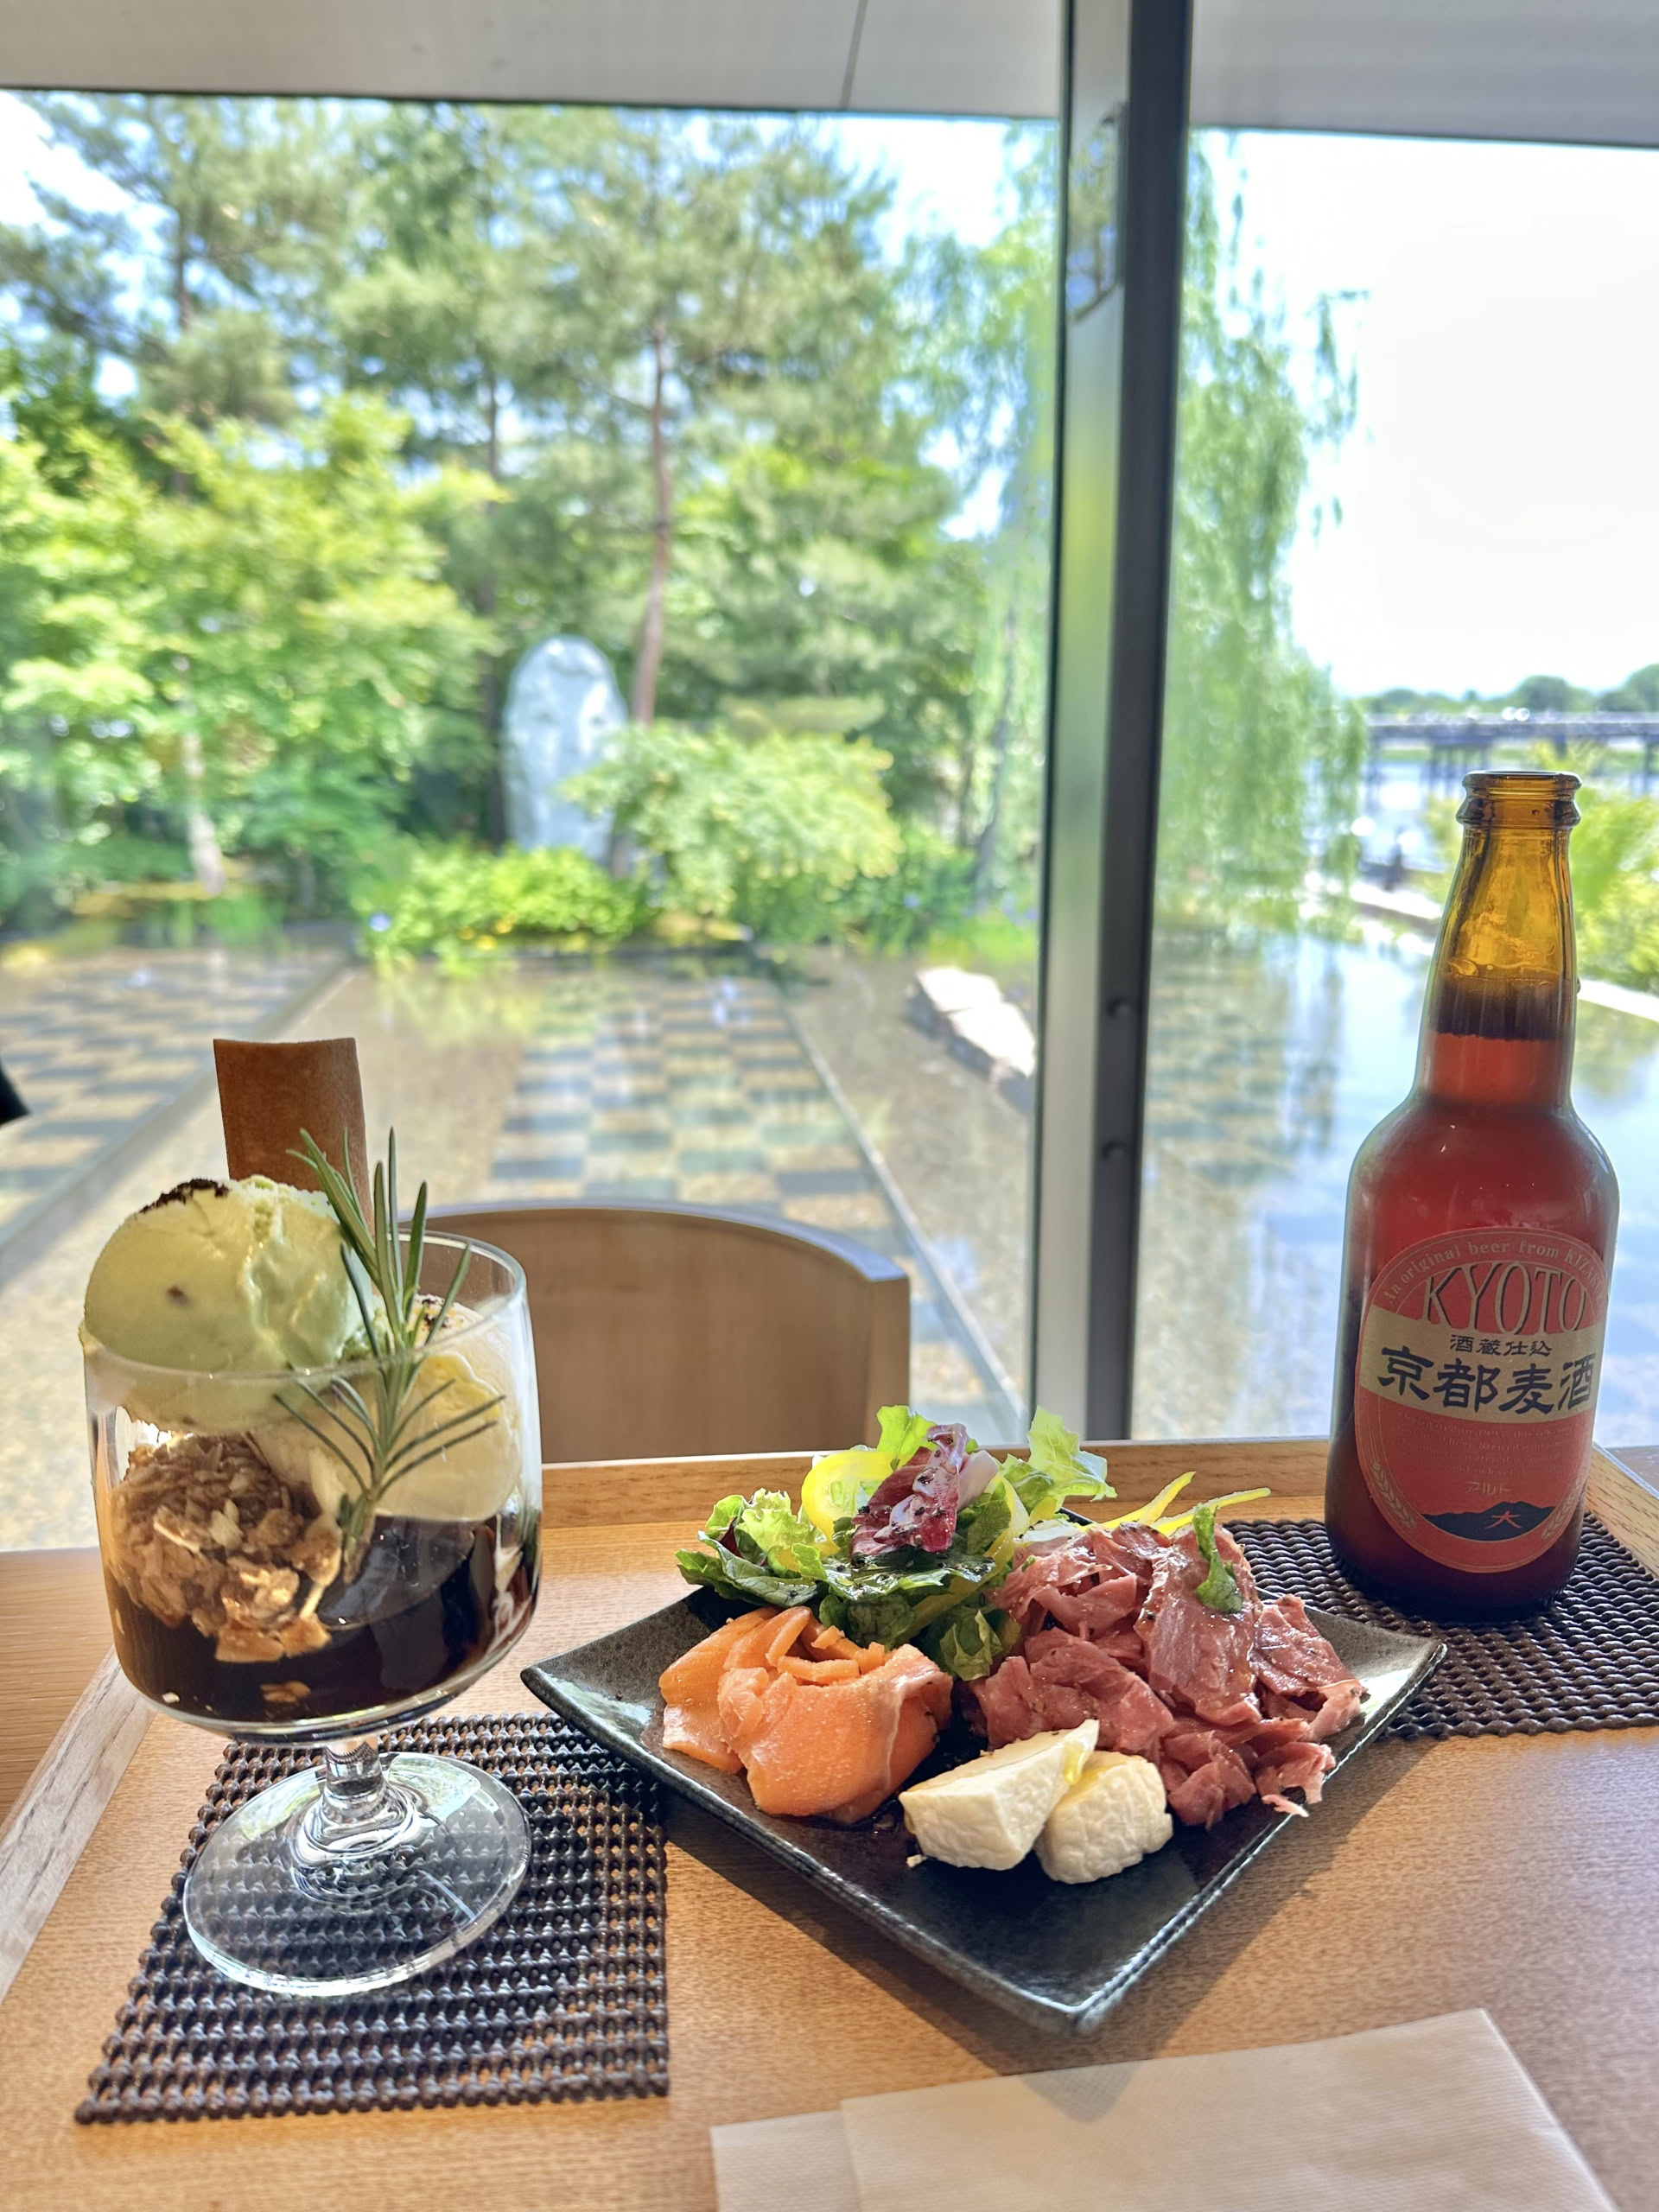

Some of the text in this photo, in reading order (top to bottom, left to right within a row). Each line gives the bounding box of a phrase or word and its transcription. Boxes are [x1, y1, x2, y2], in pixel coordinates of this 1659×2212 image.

[1383, 1284, 1402, 1304] An
[1400, 1244, 1462, 1284] original
[1467, 1241, 1510, 1255] beer
[1518, 1240, 1560, 1259] from
[1421, 1261, 1588, 1335] KYOTO
[1450, 1334, 1553, 1357] 酒蔵仕込
[1377, 1345, 1597, 1415] 京都麦酒
[1465, 1481, 1511, 1497] アルト
[1484, 1510, 1522, 1529] 大
